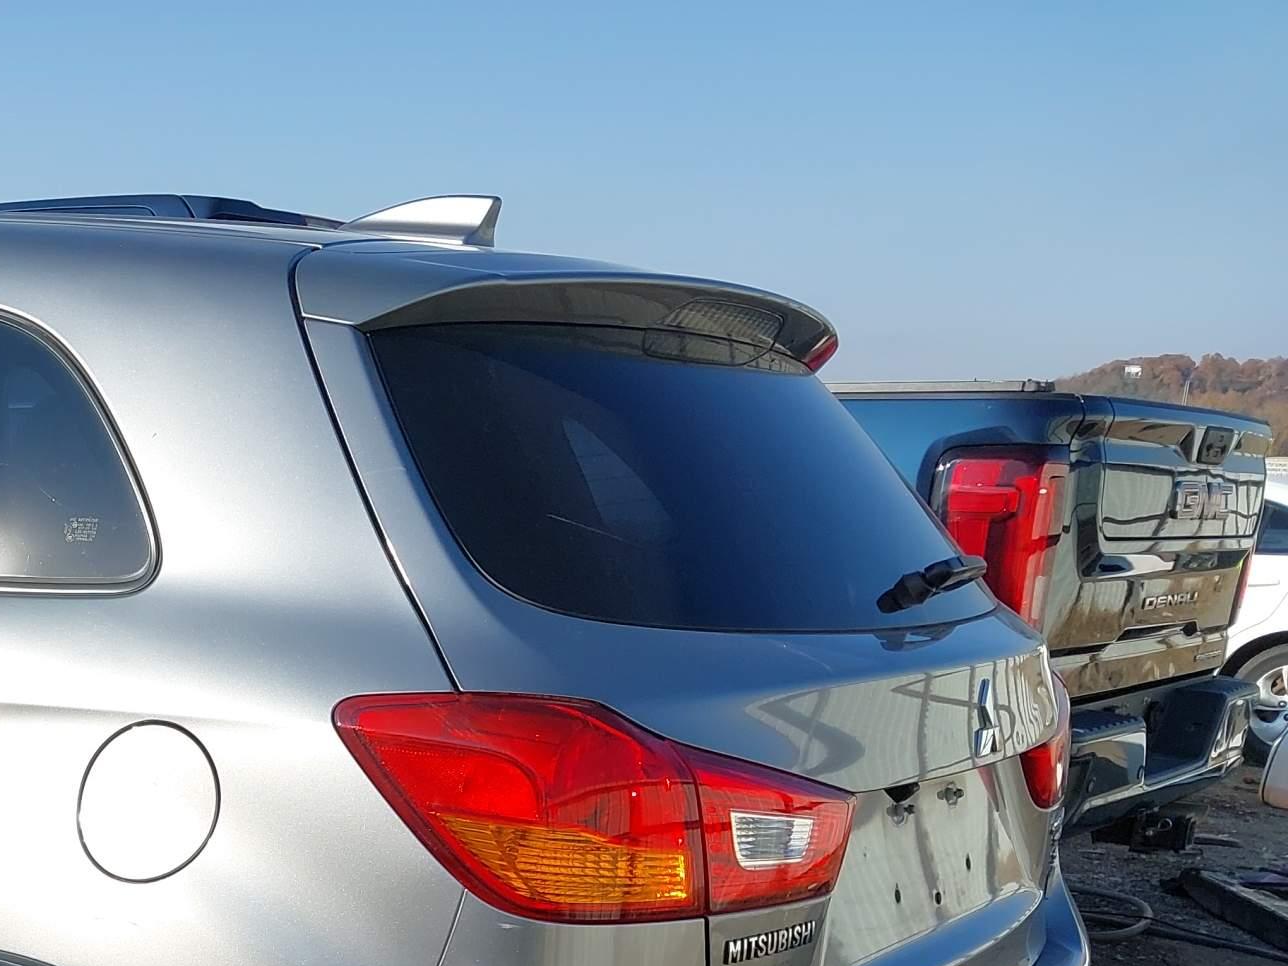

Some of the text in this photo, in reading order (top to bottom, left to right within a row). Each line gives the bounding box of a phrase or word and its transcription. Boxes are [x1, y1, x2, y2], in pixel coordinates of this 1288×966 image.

[1176, 481, 1234, 519] GMC
[1143, 591, 1199, 610] DENALI
[725, 921, 816, 965] MITSUBISHI
